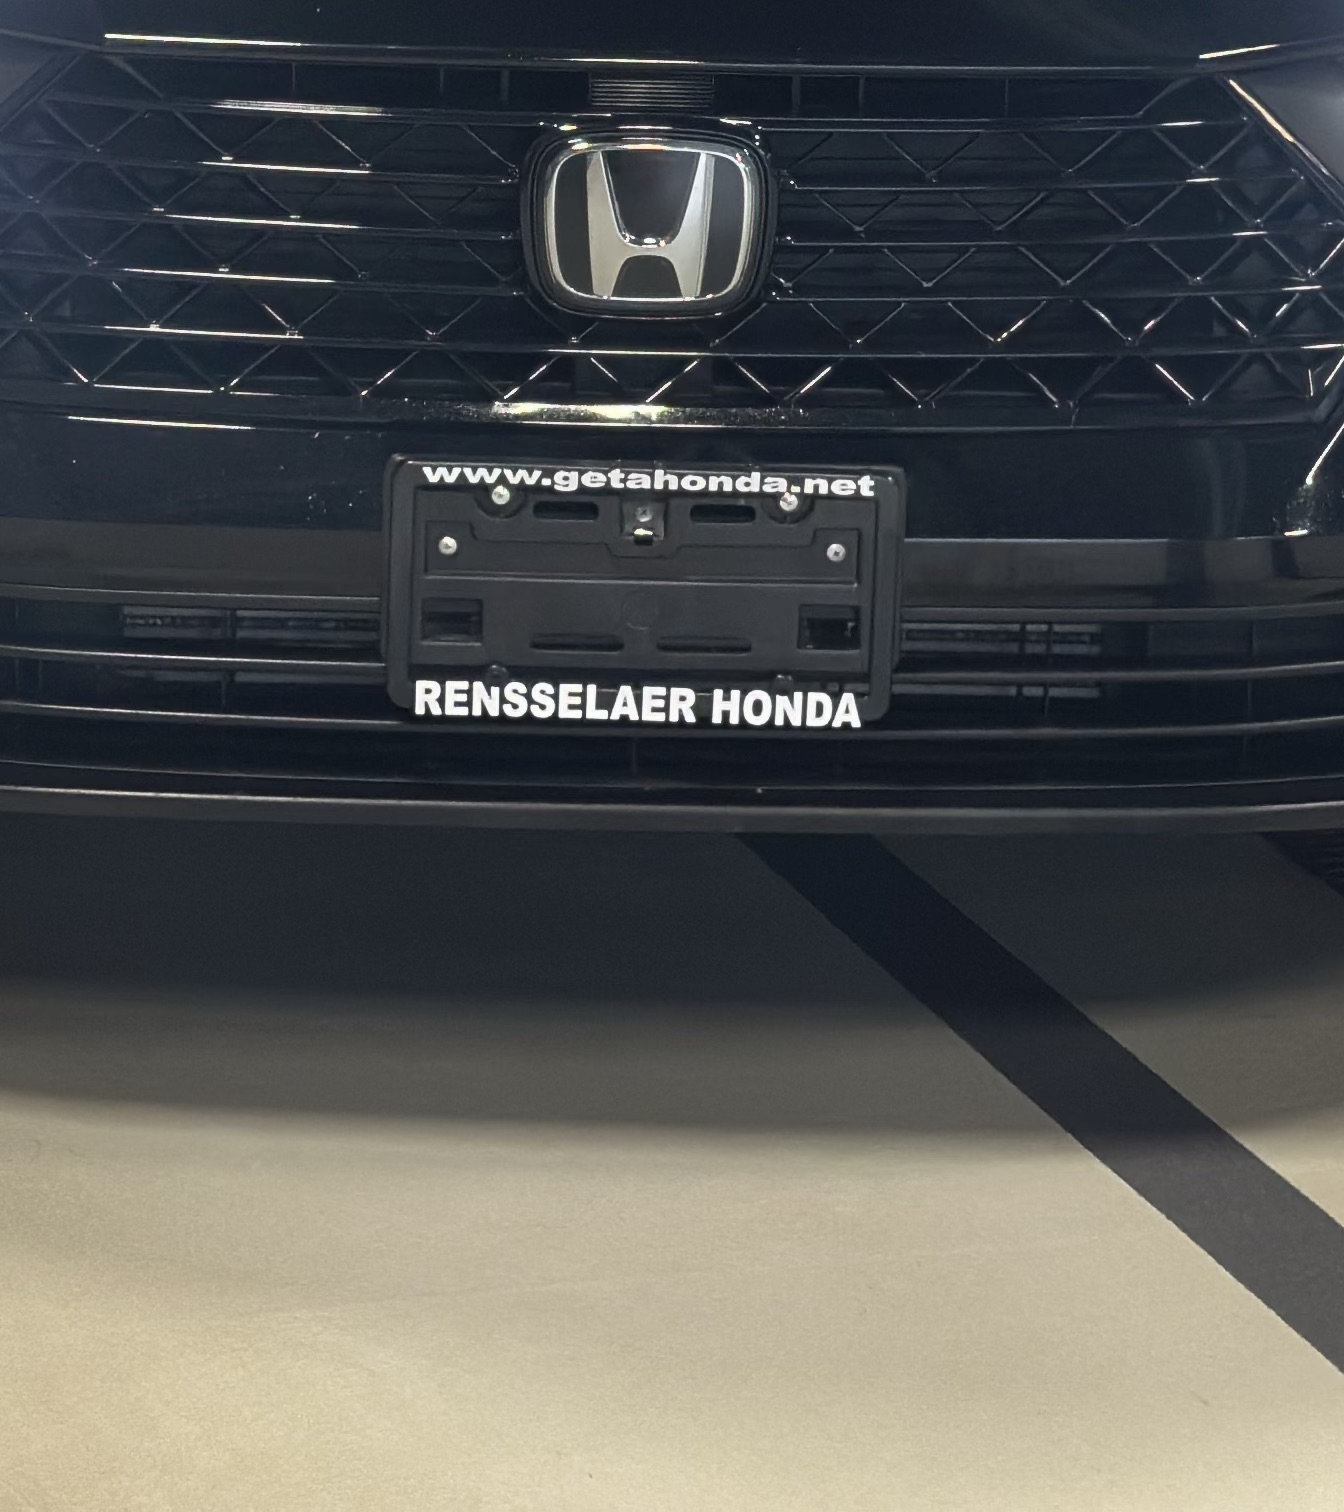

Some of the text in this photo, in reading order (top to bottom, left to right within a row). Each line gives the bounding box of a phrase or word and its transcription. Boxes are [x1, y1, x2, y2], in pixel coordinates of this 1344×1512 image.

[422, 465, 876, 497] www.getahonda.net
[414, 678, 863, 729] RENSSELAER HONDA
